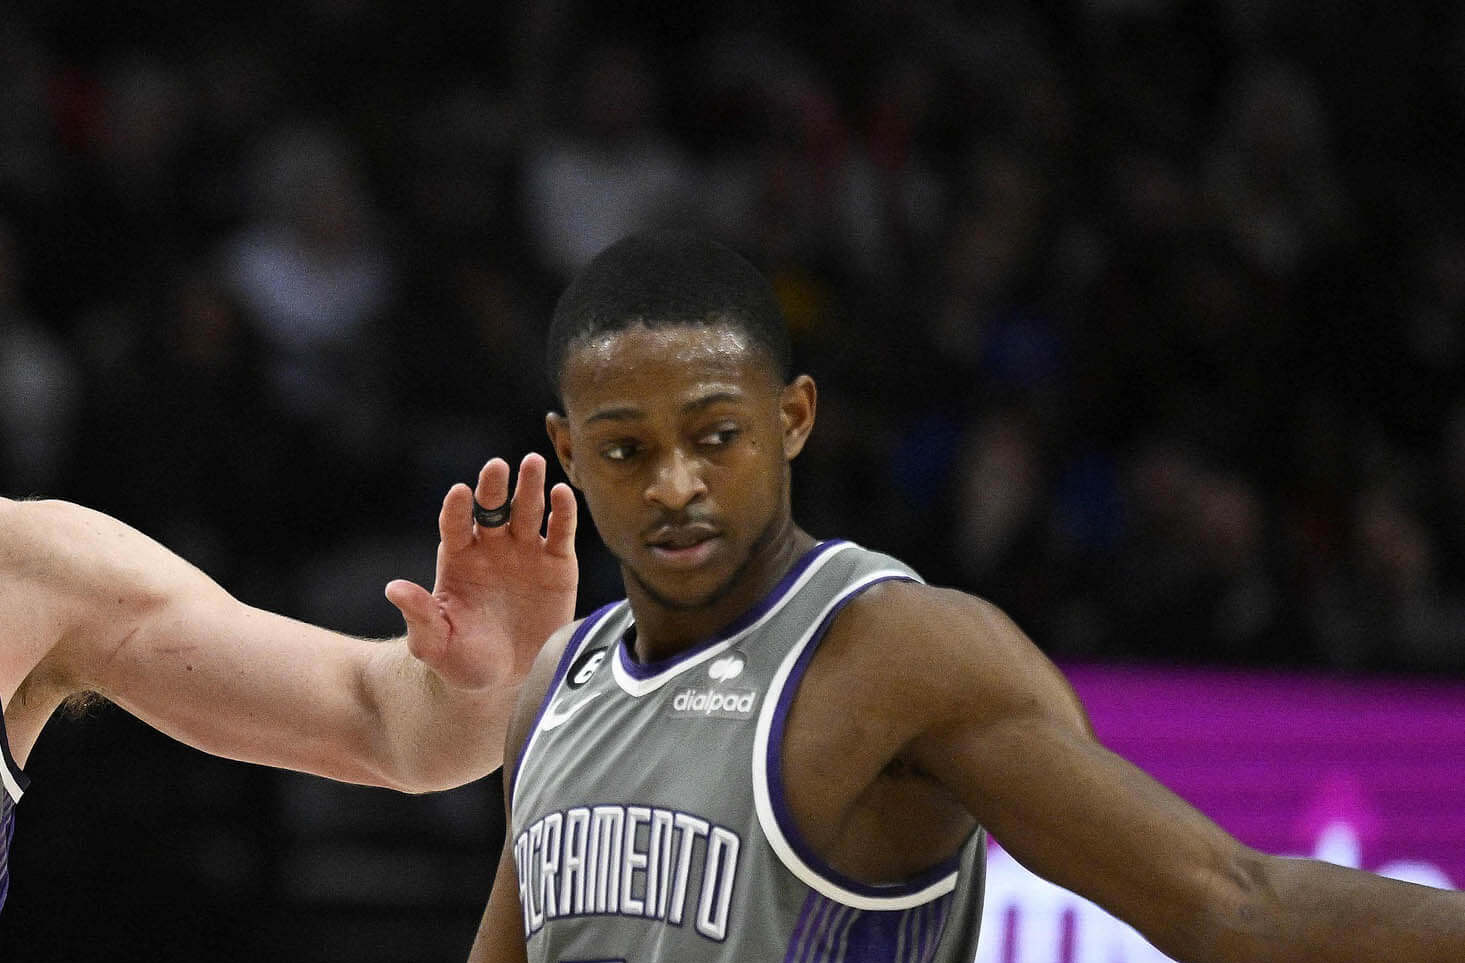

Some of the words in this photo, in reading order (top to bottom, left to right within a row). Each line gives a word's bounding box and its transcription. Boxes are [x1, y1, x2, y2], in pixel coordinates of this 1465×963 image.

[573, 651, 606, 685] 6
[673, 690, 755, 715] dialpad
[514, 805, 740, 944] ACRAMENTO
